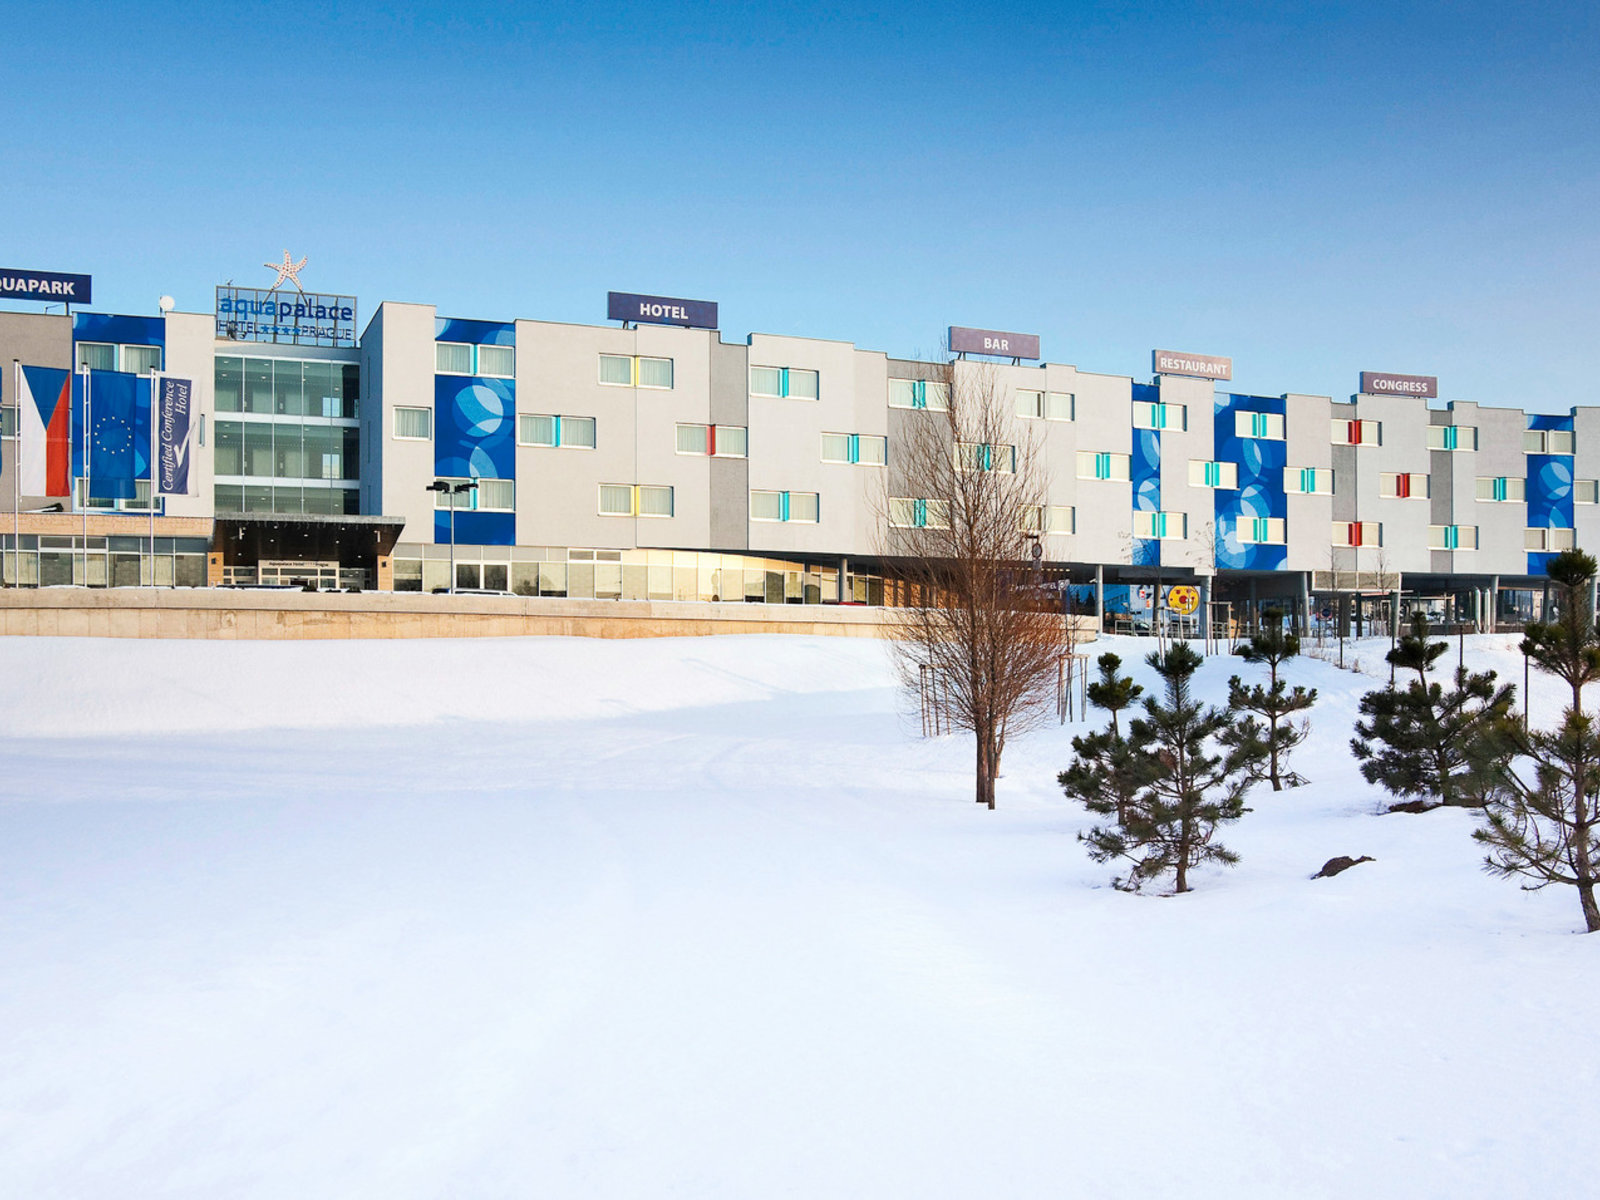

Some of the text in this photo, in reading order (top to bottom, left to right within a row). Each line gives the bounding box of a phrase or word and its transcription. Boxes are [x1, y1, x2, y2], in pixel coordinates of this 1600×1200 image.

[220, 297, 353, 323] aquapalace
[640, 303, 688, 319] HOTEL
[218, 320, 352, 340] HOTEL PRAGUE
[984, 337, 1009, 350] BAR
[1160, 357, 1227, 374] RESTAURANT
[1373, 379, 1428, 392] CONGRESS
[175, 383, 188, 415] Hotel
[162, 381, 176, 491] Certified Conference
